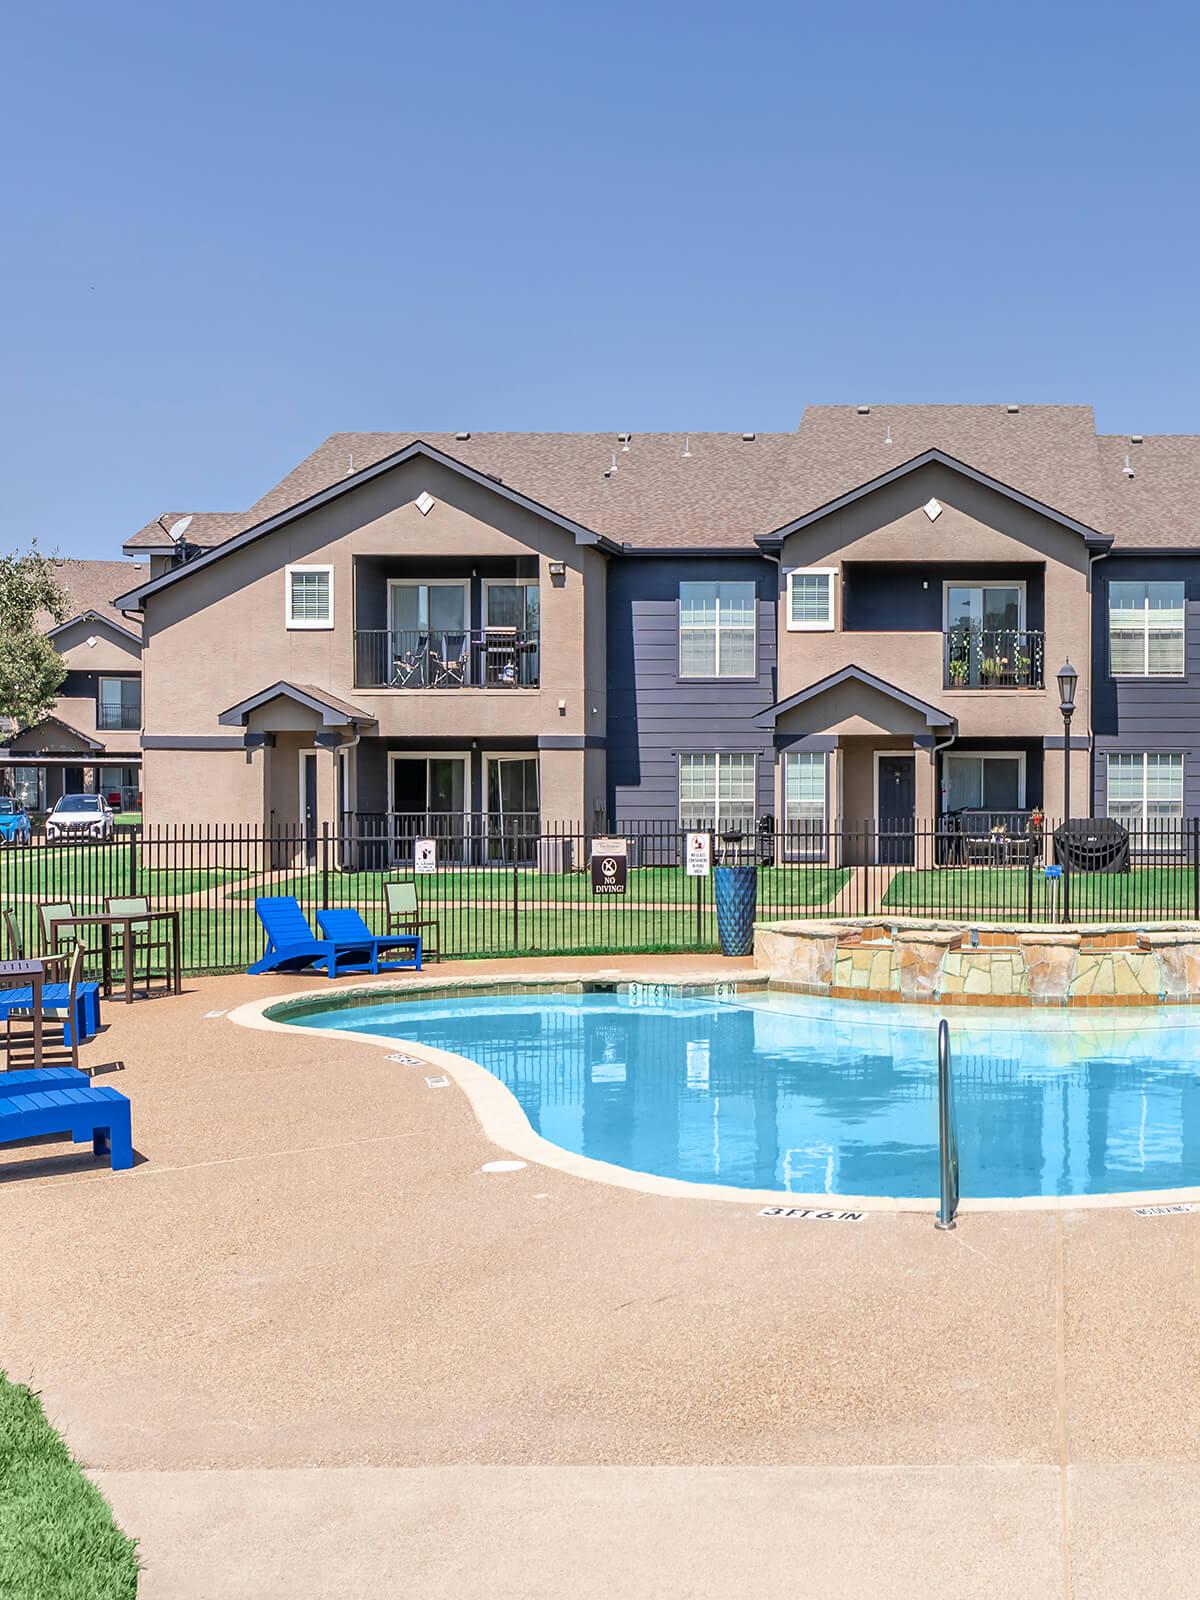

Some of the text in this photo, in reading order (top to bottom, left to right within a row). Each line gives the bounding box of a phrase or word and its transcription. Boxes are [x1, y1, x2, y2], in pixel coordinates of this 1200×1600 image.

[595, 885, 624, 893] DIVING!
[632, 983, 638, 996] 3
[653, 984, 659, 997] 6
[717, 983, 736, 996] 6 IN
[763, 1207, 864, 1220] 3 FT 6 IN
